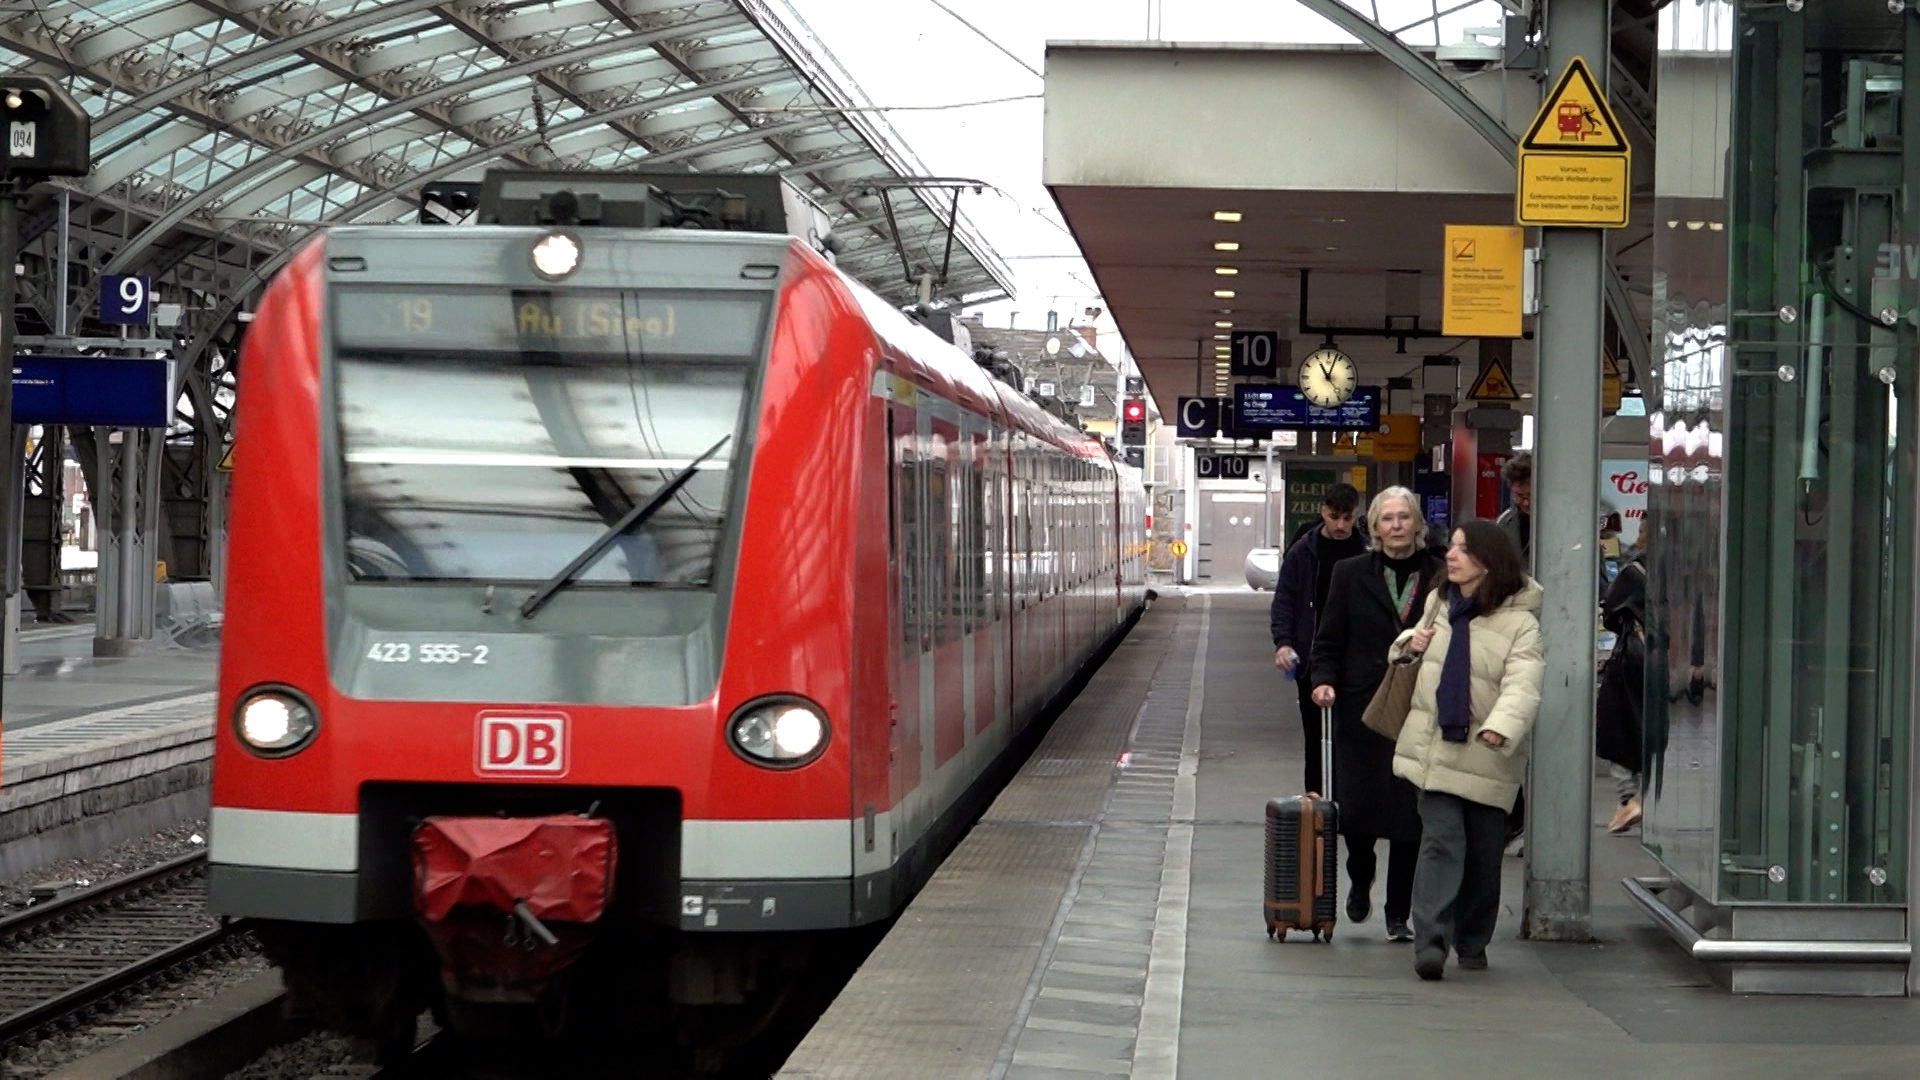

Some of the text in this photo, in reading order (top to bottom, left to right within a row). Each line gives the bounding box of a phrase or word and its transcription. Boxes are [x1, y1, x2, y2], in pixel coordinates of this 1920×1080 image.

[13, 129, 32, 148] 094
[119, 277, 144, 314] 9
[1236, 334, 1272, 367] 10
[1183, 398, 1206, 430] C
[1200, 457, 1213, 475] D
[1223, 458, 1244, 475] 10
[1291, 501, 1322, 514] ZEH
[367, 642, 489, 665] 423 555-2
[488, 722, 558, 767] DB
